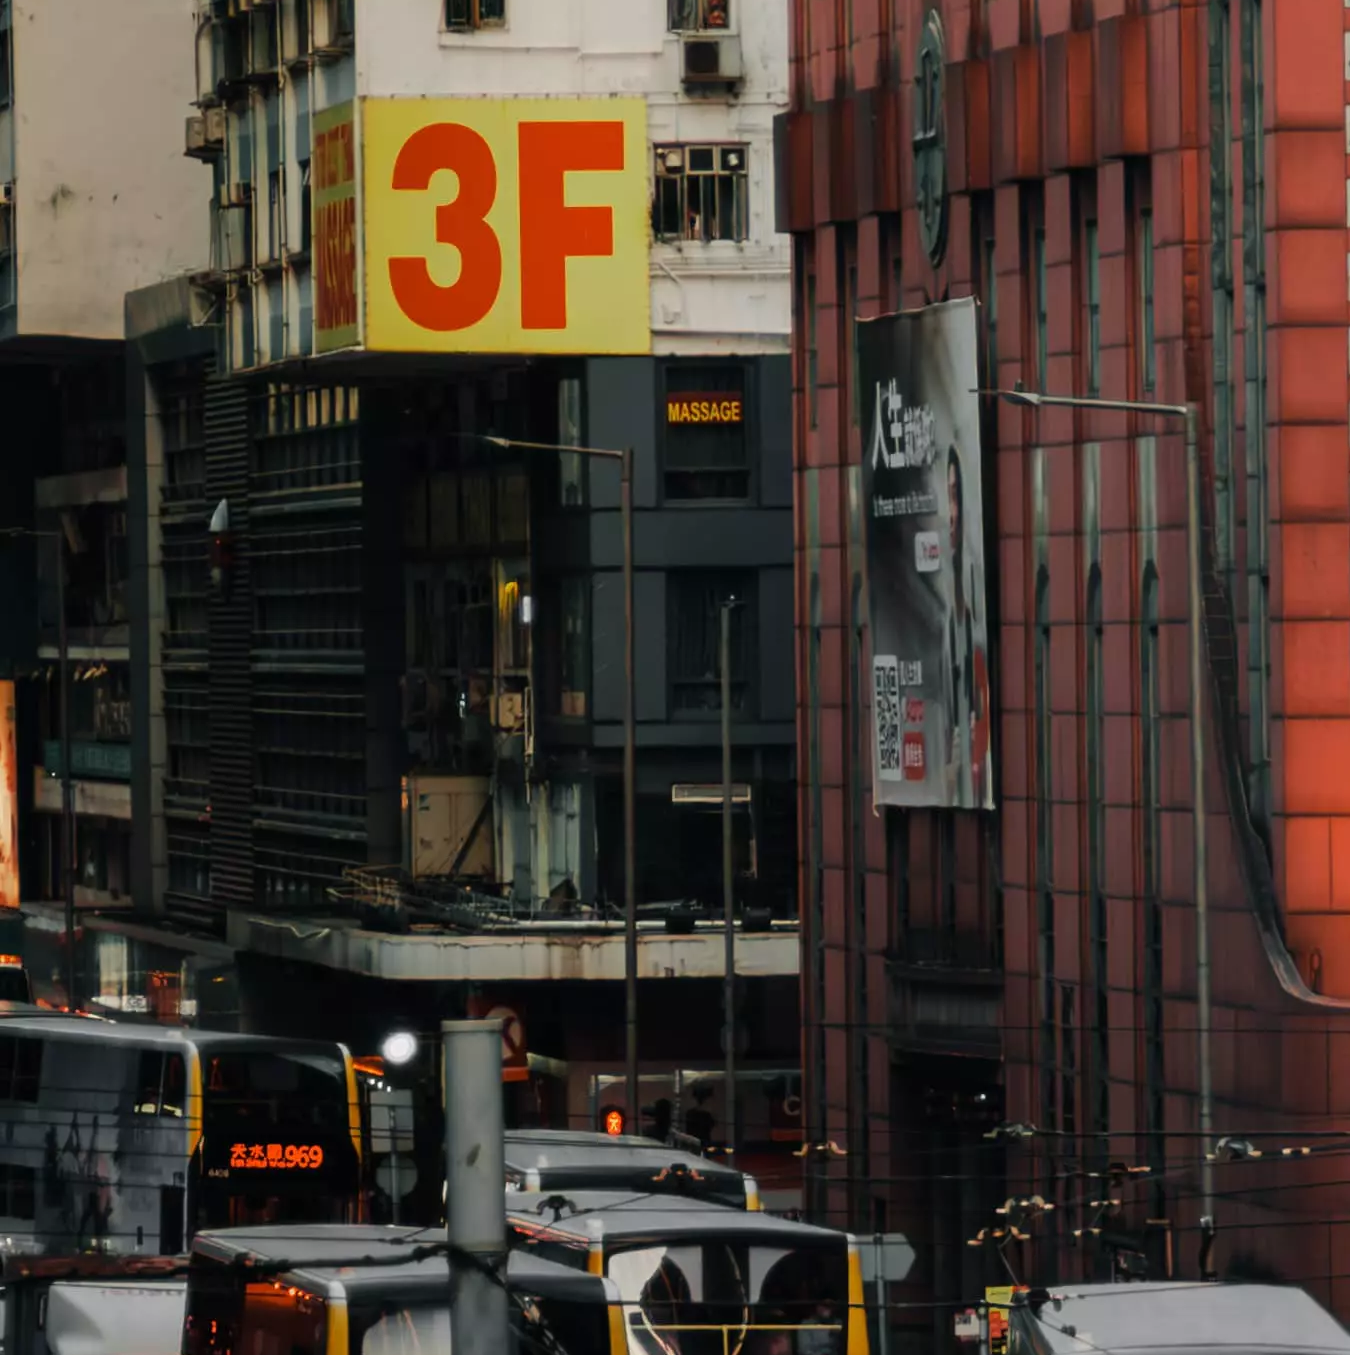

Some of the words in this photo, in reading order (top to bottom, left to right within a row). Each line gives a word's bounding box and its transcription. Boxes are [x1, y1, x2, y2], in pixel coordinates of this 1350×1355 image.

[388, 121, 625, 332] 3F
[667, 402, 741, 422] MASSAGE
[285, 1145, 323, 1168] 969
